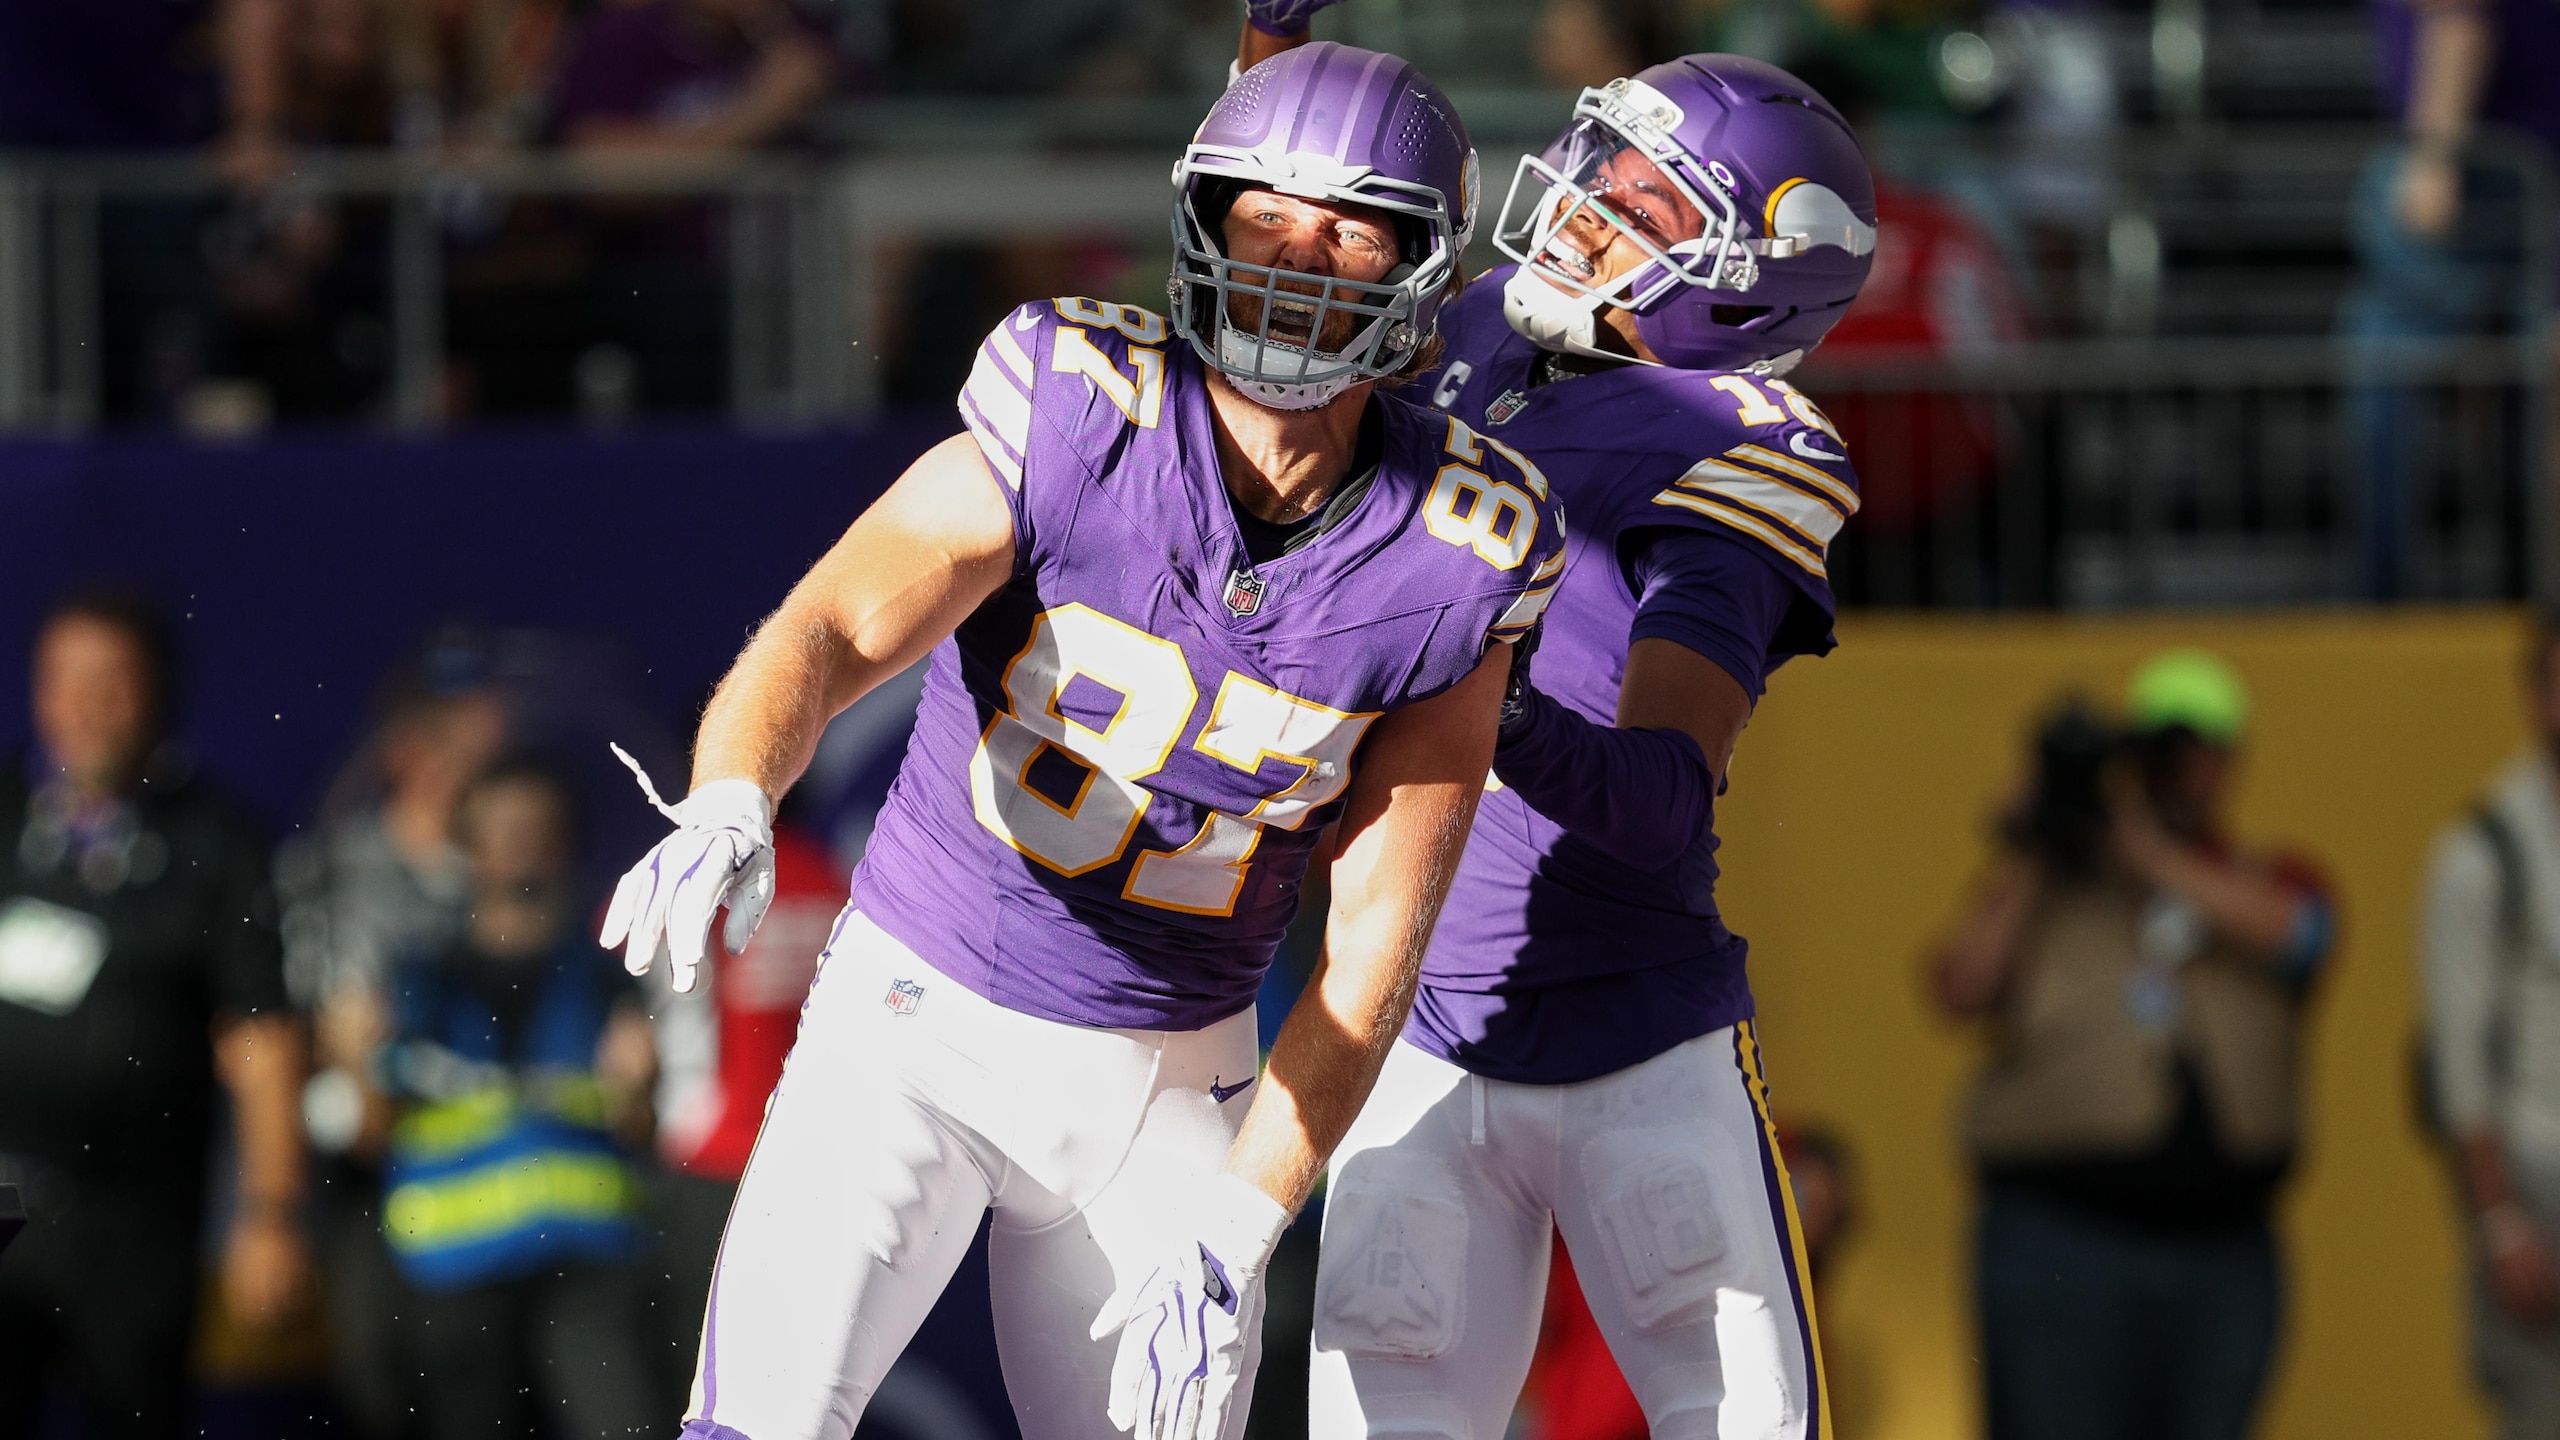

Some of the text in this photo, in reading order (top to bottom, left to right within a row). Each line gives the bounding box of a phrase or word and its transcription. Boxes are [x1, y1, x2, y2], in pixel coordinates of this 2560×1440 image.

[1051, 296, 1168, 429] 87
[1433, 360, 1472, 408] C
[1229, 587, 1256, 610] NFL
[969, 602, 1384, 917] 87
[888, 990, 912, 1011] NFL
